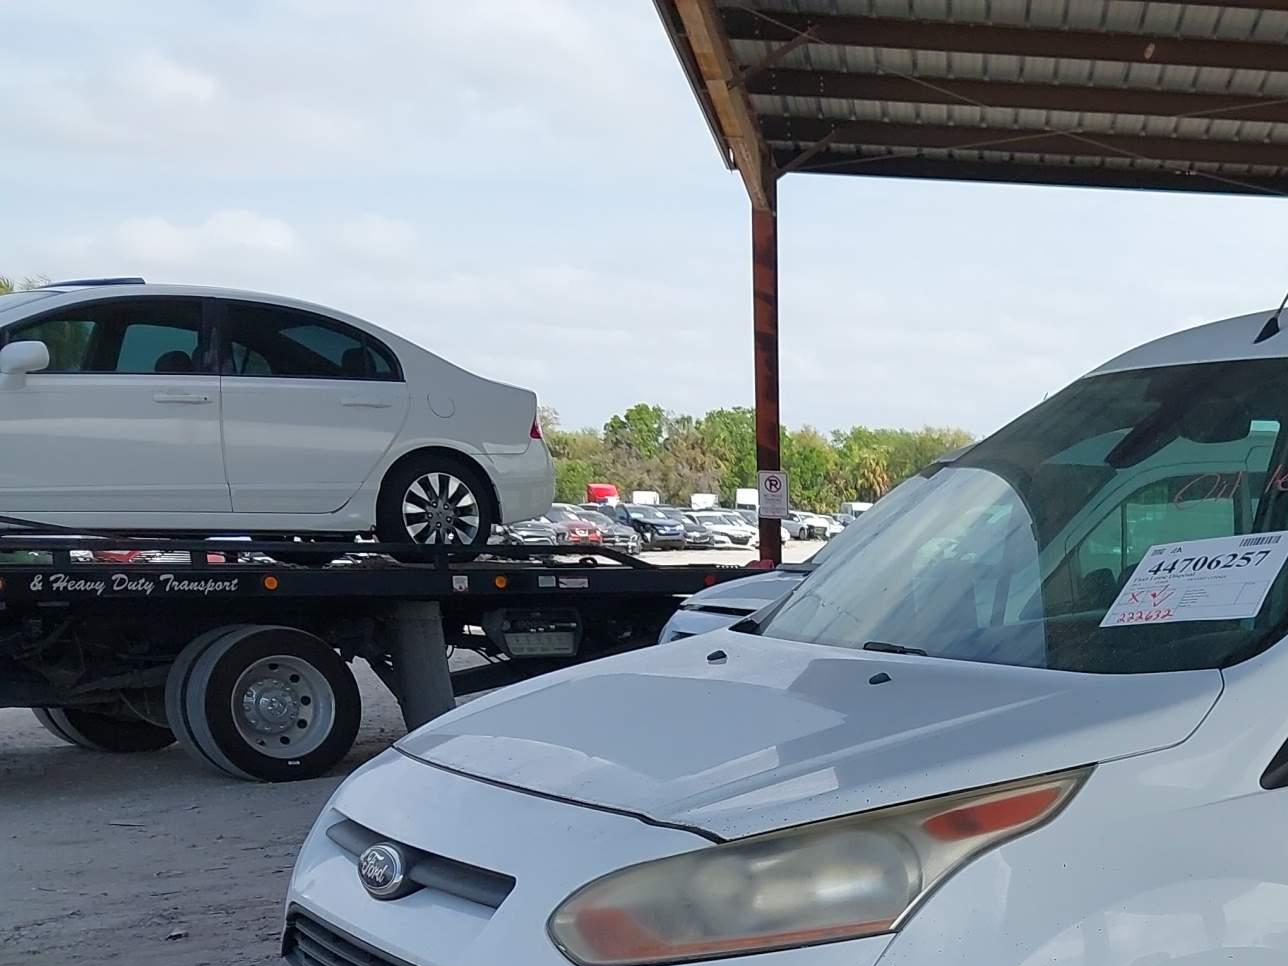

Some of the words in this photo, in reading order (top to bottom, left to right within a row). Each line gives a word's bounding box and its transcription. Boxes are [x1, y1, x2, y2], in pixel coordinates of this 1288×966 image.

[1174, 471, 1242, 510] Oil
[1147, 549, 1272, 575] 44706257
[30, 574, 43, 591] &
[50, 573, 105, 595] Heavy
[111, 573, 155, 595] Duty
[159, 573, 239, 595] Transport
[361, 850, 389, 883] Ford
